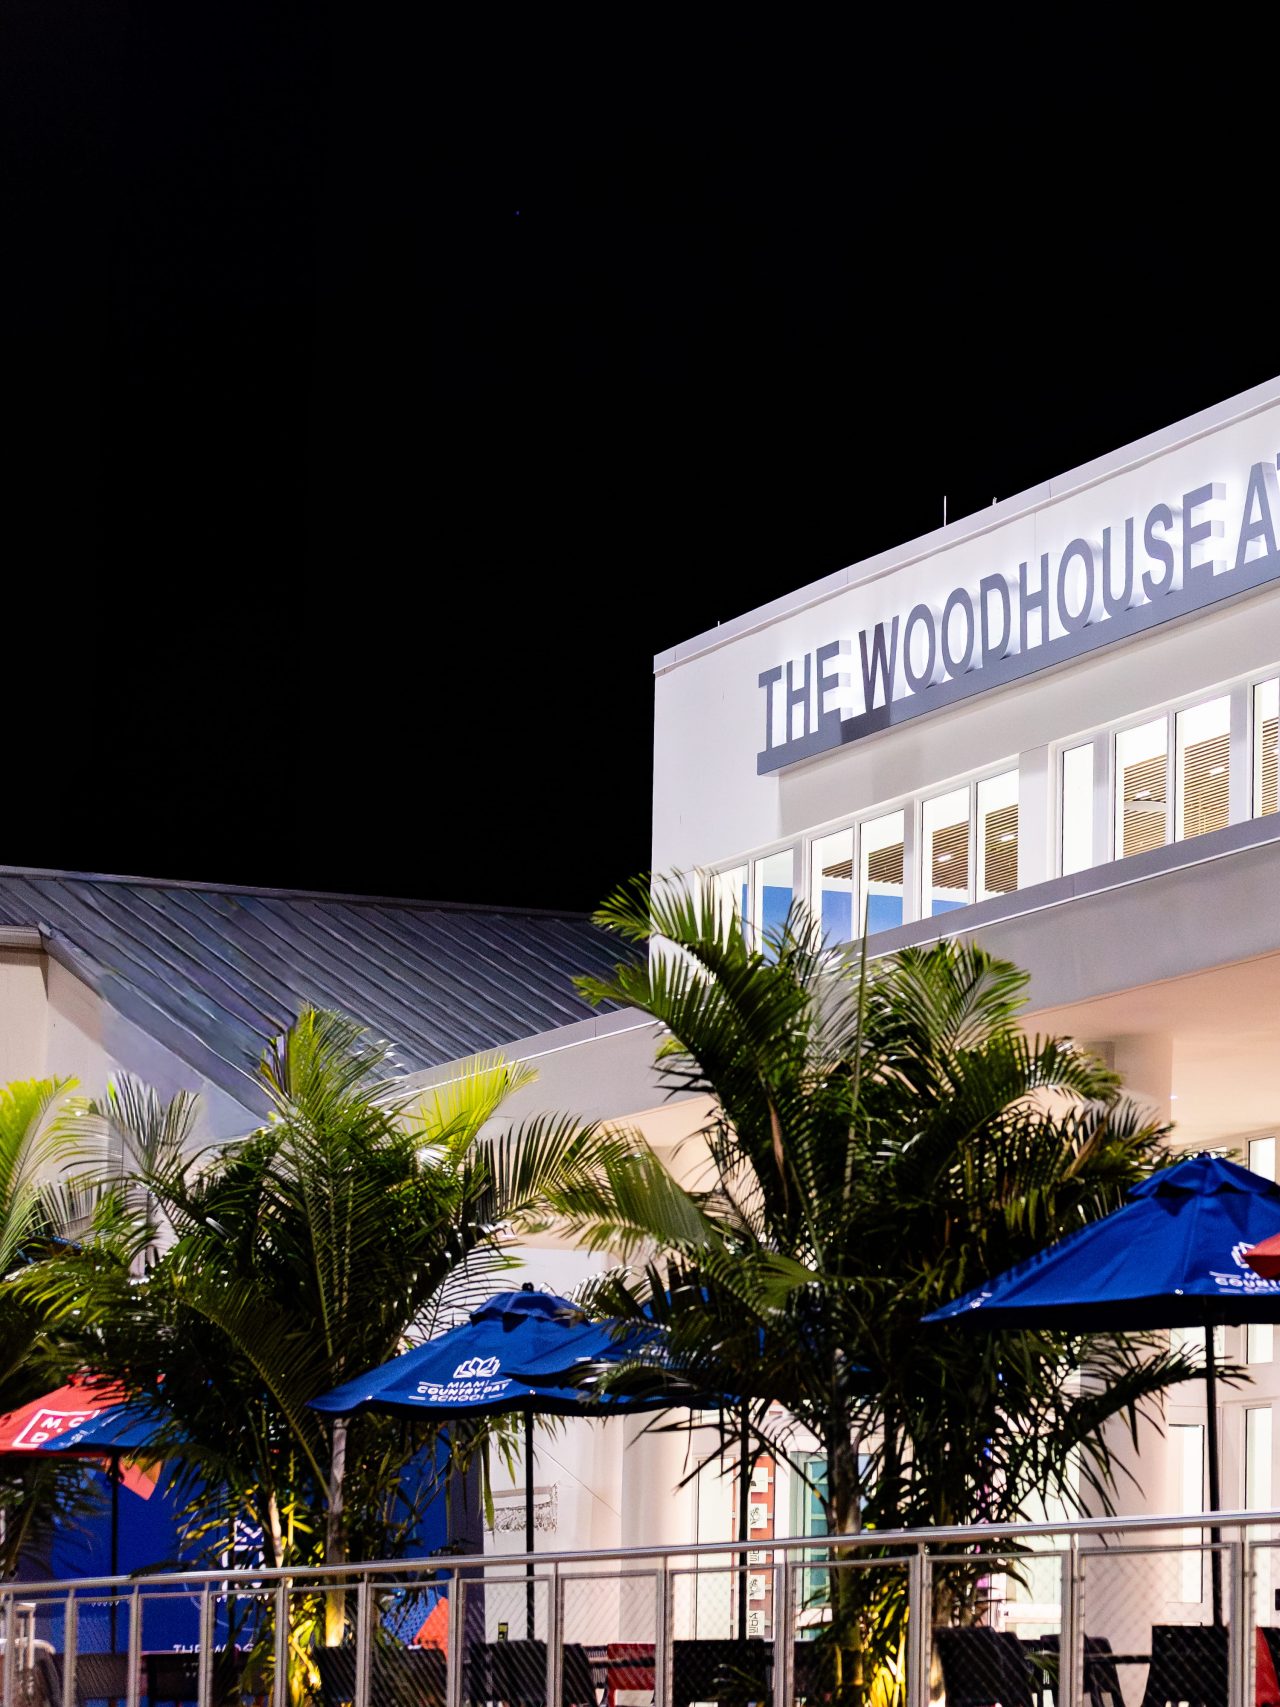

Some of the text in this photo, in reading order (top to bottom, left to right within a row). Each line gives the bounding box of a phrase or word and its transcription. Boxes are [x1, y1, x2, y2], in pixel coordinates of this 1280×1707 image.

[758, 640, 846, 753] THE
[858, 482, 1222, 714] WOODHOUSE
[417, 1382, 510, 1396] COUNTRY DAY
[447, 1380, 490, 1389] MIAMI
[429, 1394, 486, 1402] SCHOOL
